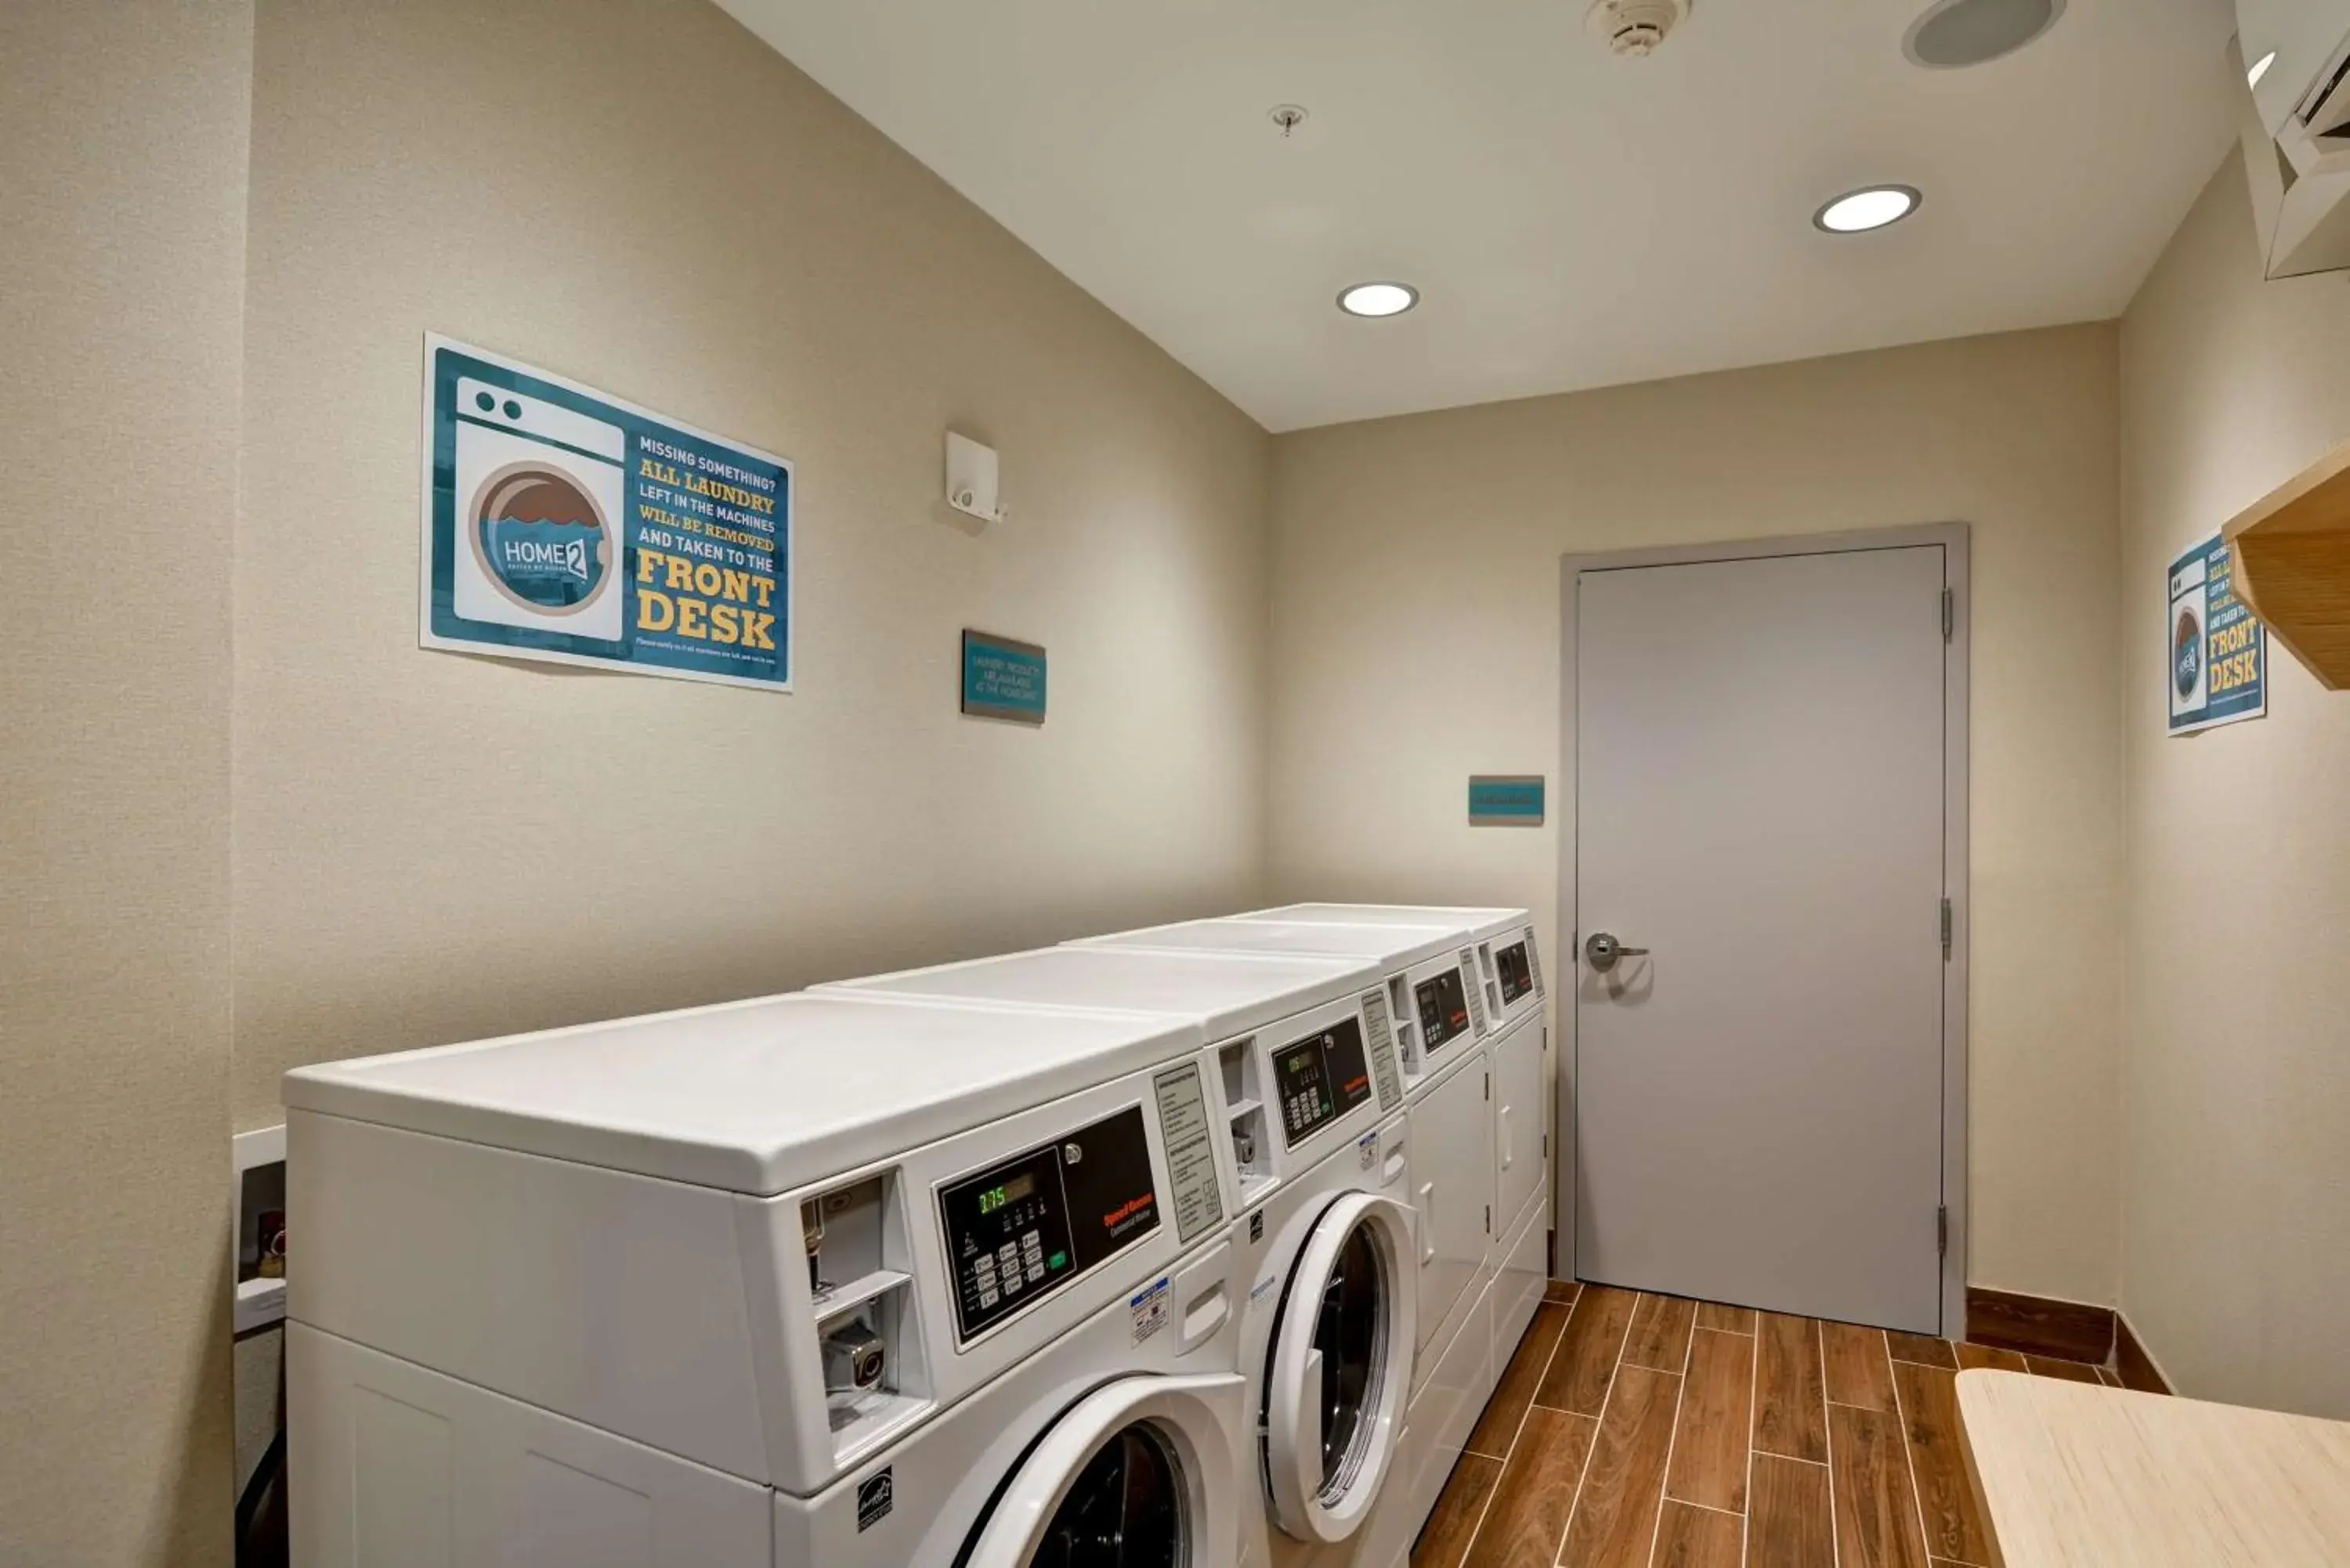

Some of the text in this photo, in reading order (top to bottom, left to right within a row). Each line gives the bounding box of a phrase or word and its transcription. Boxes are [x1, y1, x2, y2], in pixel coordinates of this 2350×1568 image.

[639, 457, 776, 515] ALL LAUNDRY
[640, 436, 776, 493] MISSING SOMETHING?
[639, 504, 774, 552] WILL BE REMOVED
[640, 482, 775, 533] LEFT IN THE MACHINES
[639, 526, 774, 573] AND TAKEN TO THE
[637, 547, 776, 608] FRONT
[637, 588, 776, 650] DESK
[2210, 616, 2257, 659] FRONT
[2210, 648, 2257, 694] DESK
